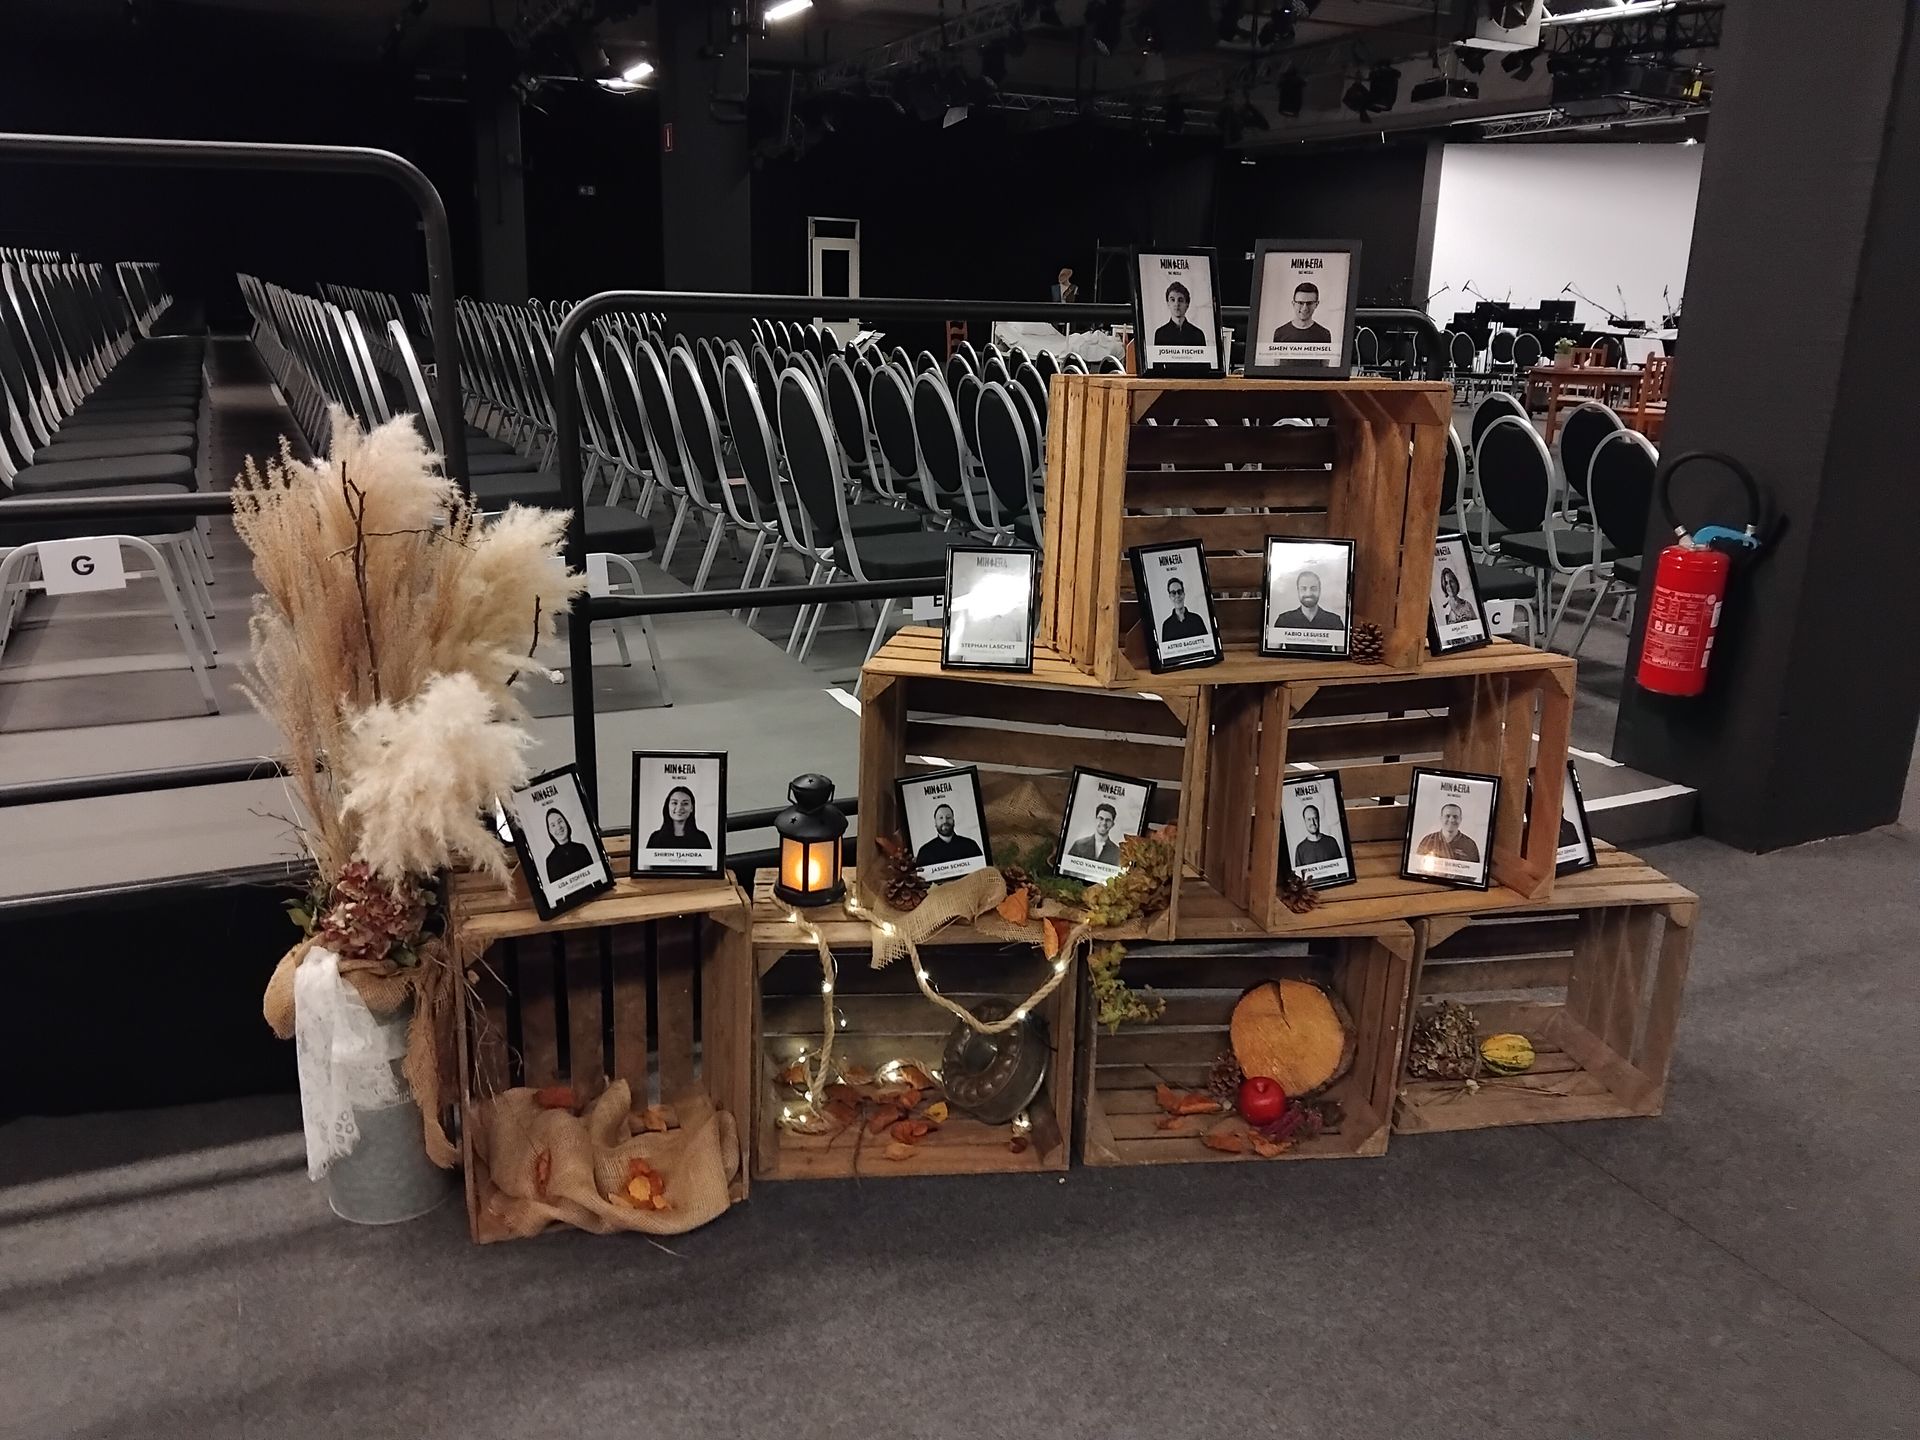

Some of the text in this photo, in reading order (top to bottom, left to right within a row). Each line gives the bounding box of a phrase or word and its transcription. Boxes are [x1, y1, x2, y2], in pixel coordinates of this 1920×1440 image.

[70, 555, 95, 577] G
[933, 595, 943, 608] E
[1491, 611, 1501, 625] C
[931, 866, 949, 874] JASON
[950, 861, 971, 869] SCHOLL
